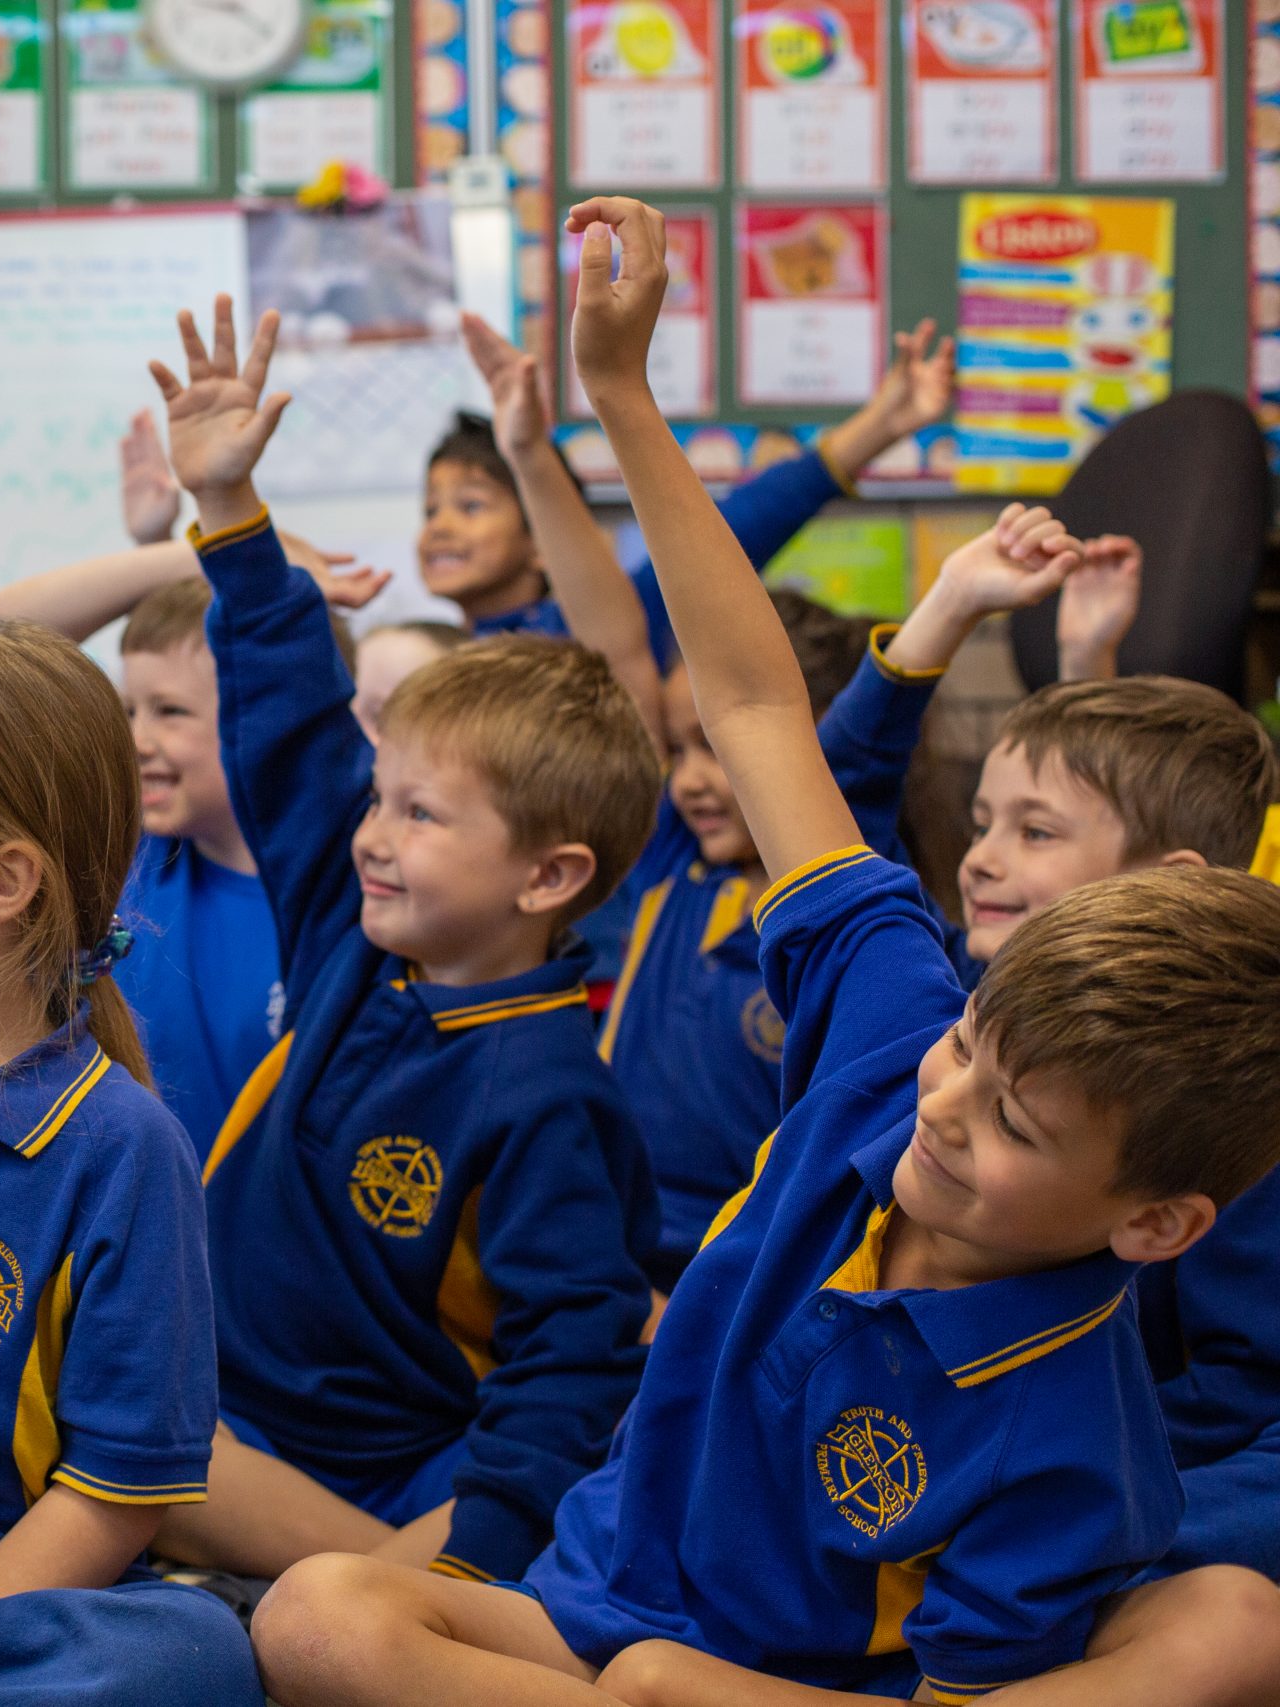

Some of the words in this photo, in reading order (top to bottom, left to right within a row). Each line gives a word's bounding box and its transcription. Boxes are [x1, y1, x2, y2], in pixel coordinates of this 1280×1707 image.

[841, 1407, 884, 1421] TRUTH
[888, 1414, 913, 1439] AND
[817, 1444, 840, 1502] PRIMARY
[849, 1434, 901, 1512] GLENCOE
